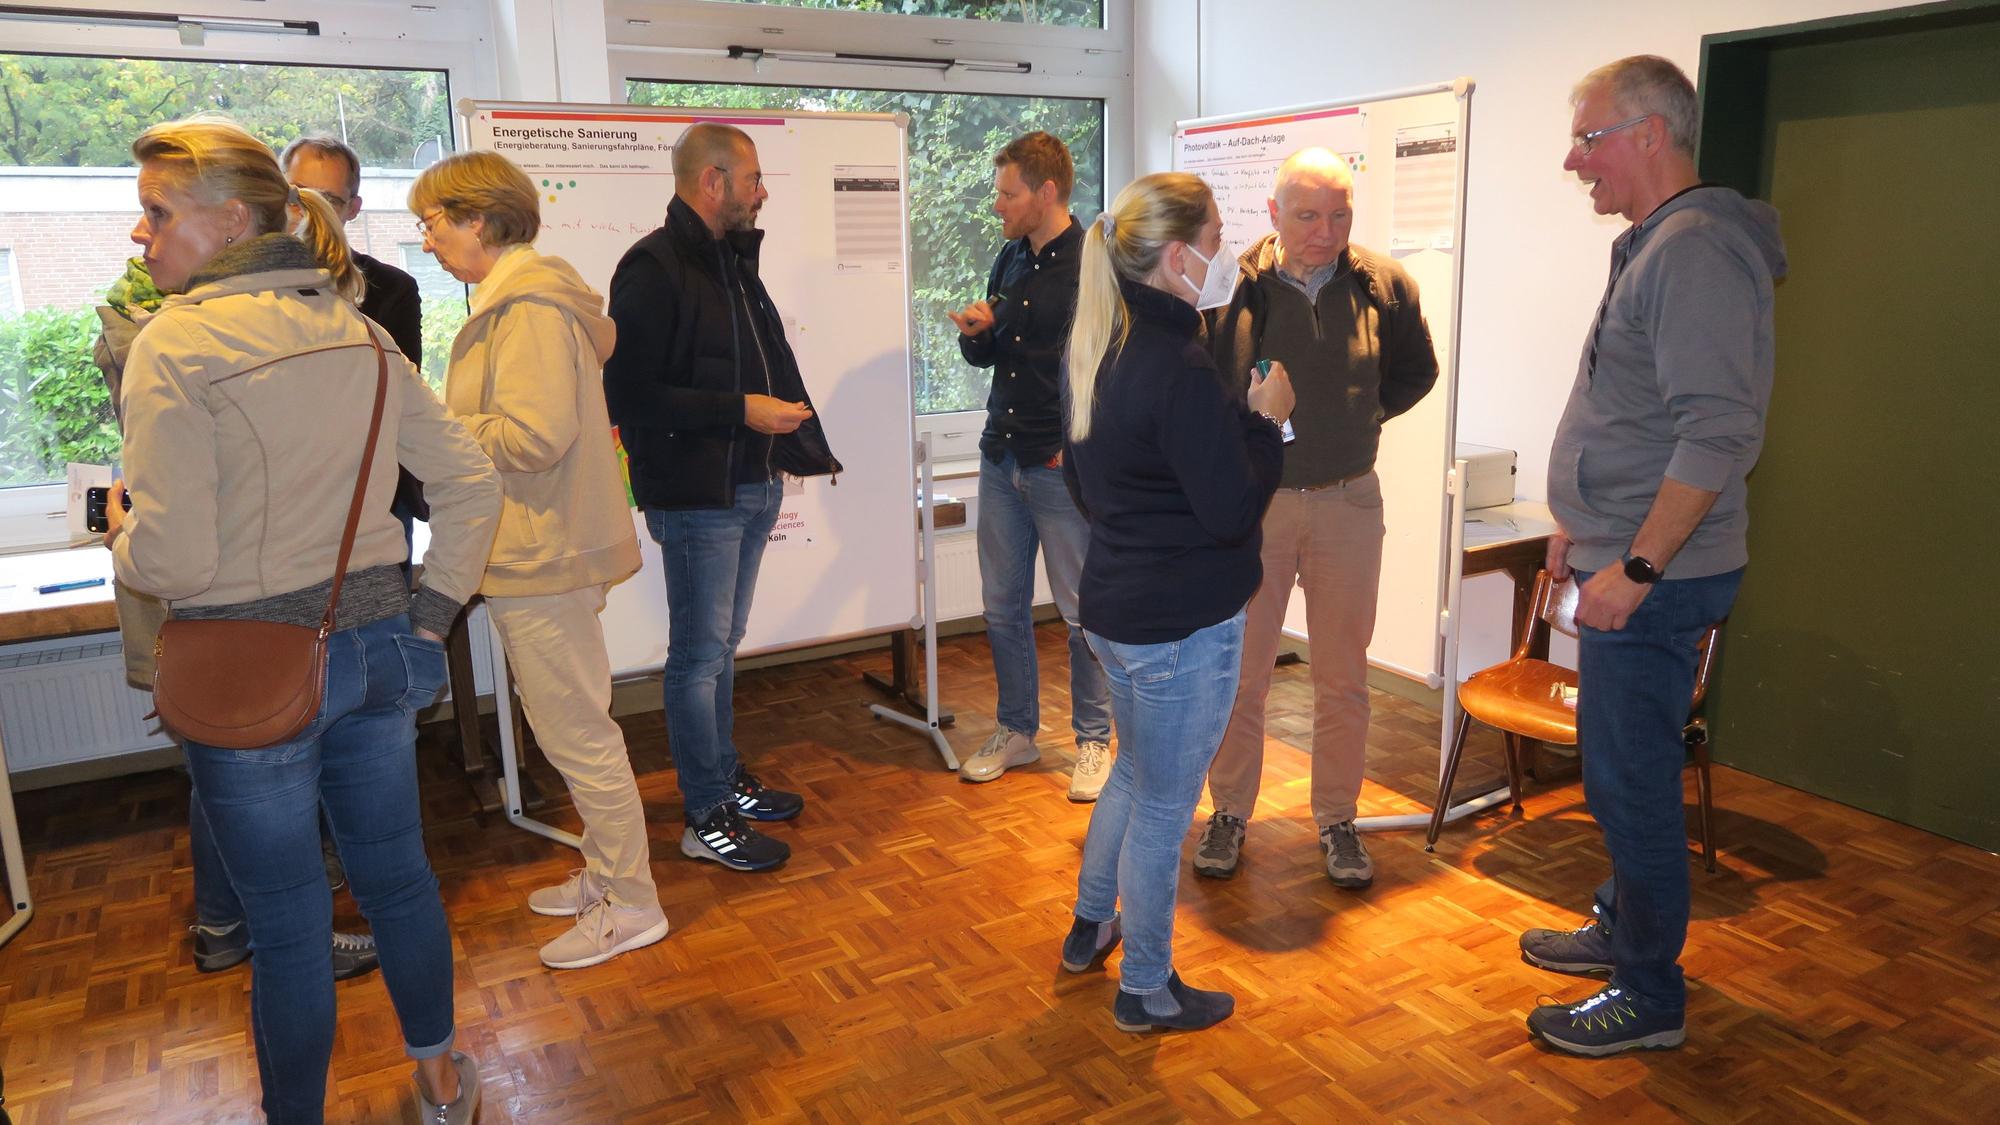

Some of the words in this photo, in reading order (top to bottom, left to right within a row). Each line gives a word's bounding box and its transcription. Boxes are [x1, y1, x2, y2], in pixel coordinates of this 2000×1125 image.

[493, 126, 574, 140] Energetische
[577, 128, 638, 141] Sanierung
[494, 141, 570, 151] (Energieberatung,
[572, 142, 656, 152] Sanierungsfahrpläne,
[1184, 140, 1221, 152] Photovoltaik
[1228, 134, 1285, 147] Auf-Dach-Anlage
[768, 533, 786, 542] Köln
